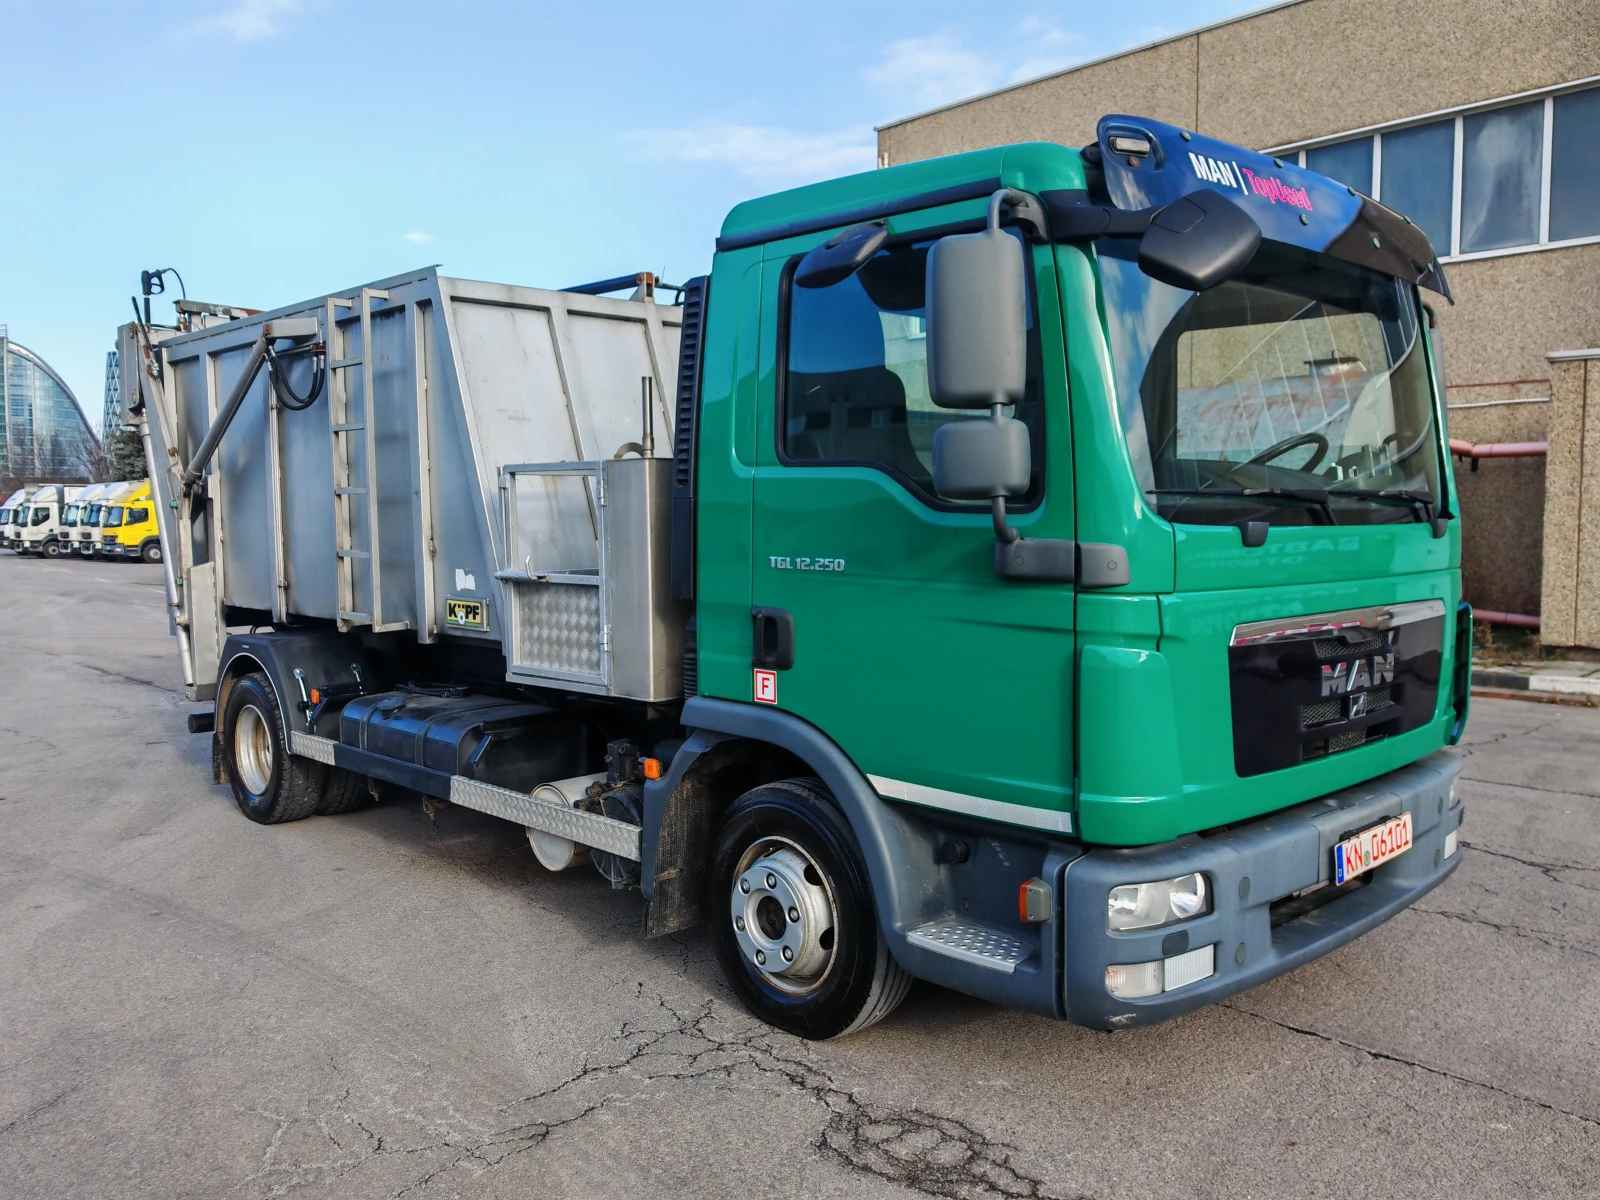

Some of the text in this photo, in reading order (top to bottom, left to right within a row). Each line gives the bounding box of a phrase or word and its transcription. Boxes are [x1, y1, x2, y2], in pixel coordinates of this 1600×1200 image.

[1188, 151, 1314, 211] MAN TopUsed
[768, 556, 845, 571] TGL 12.250
[761, 677, 770, 695] F
[1320, 652, 1395, 697] MAN
[1345, 819, 1409, 875] KN 06101
